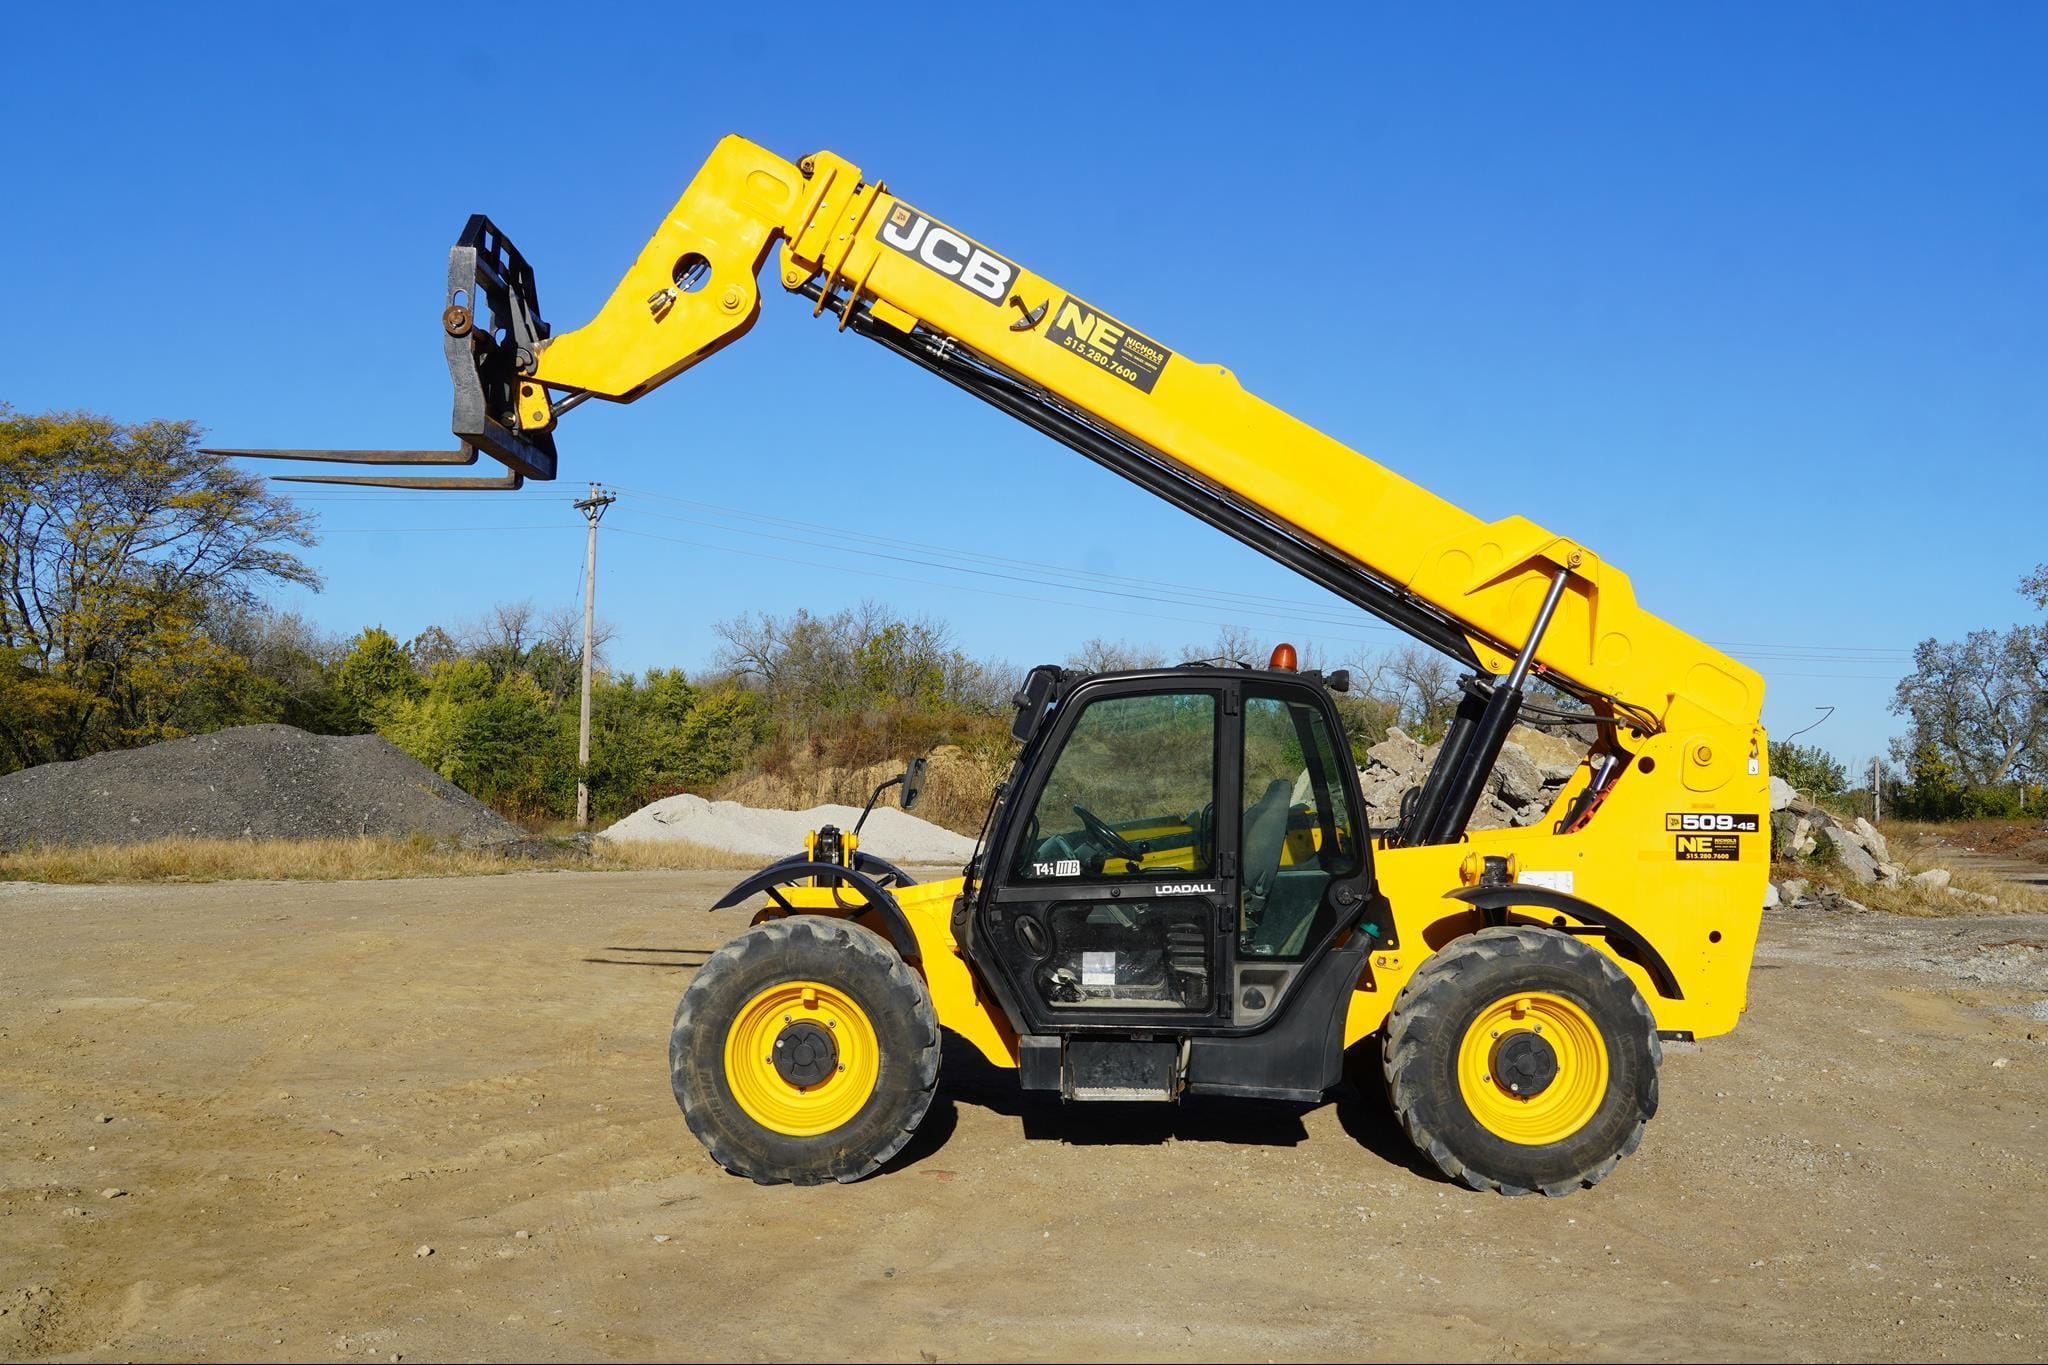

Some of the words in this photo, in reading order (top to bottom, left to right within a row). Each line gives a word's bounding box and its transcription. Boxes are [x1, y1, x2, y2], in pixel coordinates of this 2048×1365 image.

[883, 217, 1010, 298] JCB
[1057, 301, 1124, 356] NE
[1124, 336, 1164, 361] NICHOLS
[1063, 336, 1137, 382] 515.280.7600
[1682, 815, 1756, 830] 509-42
[1678, 837, 1713, 852] NE
[1033, 863, 1055, 875] T4i
[1155, 884, 1216, 896] LOADALL
